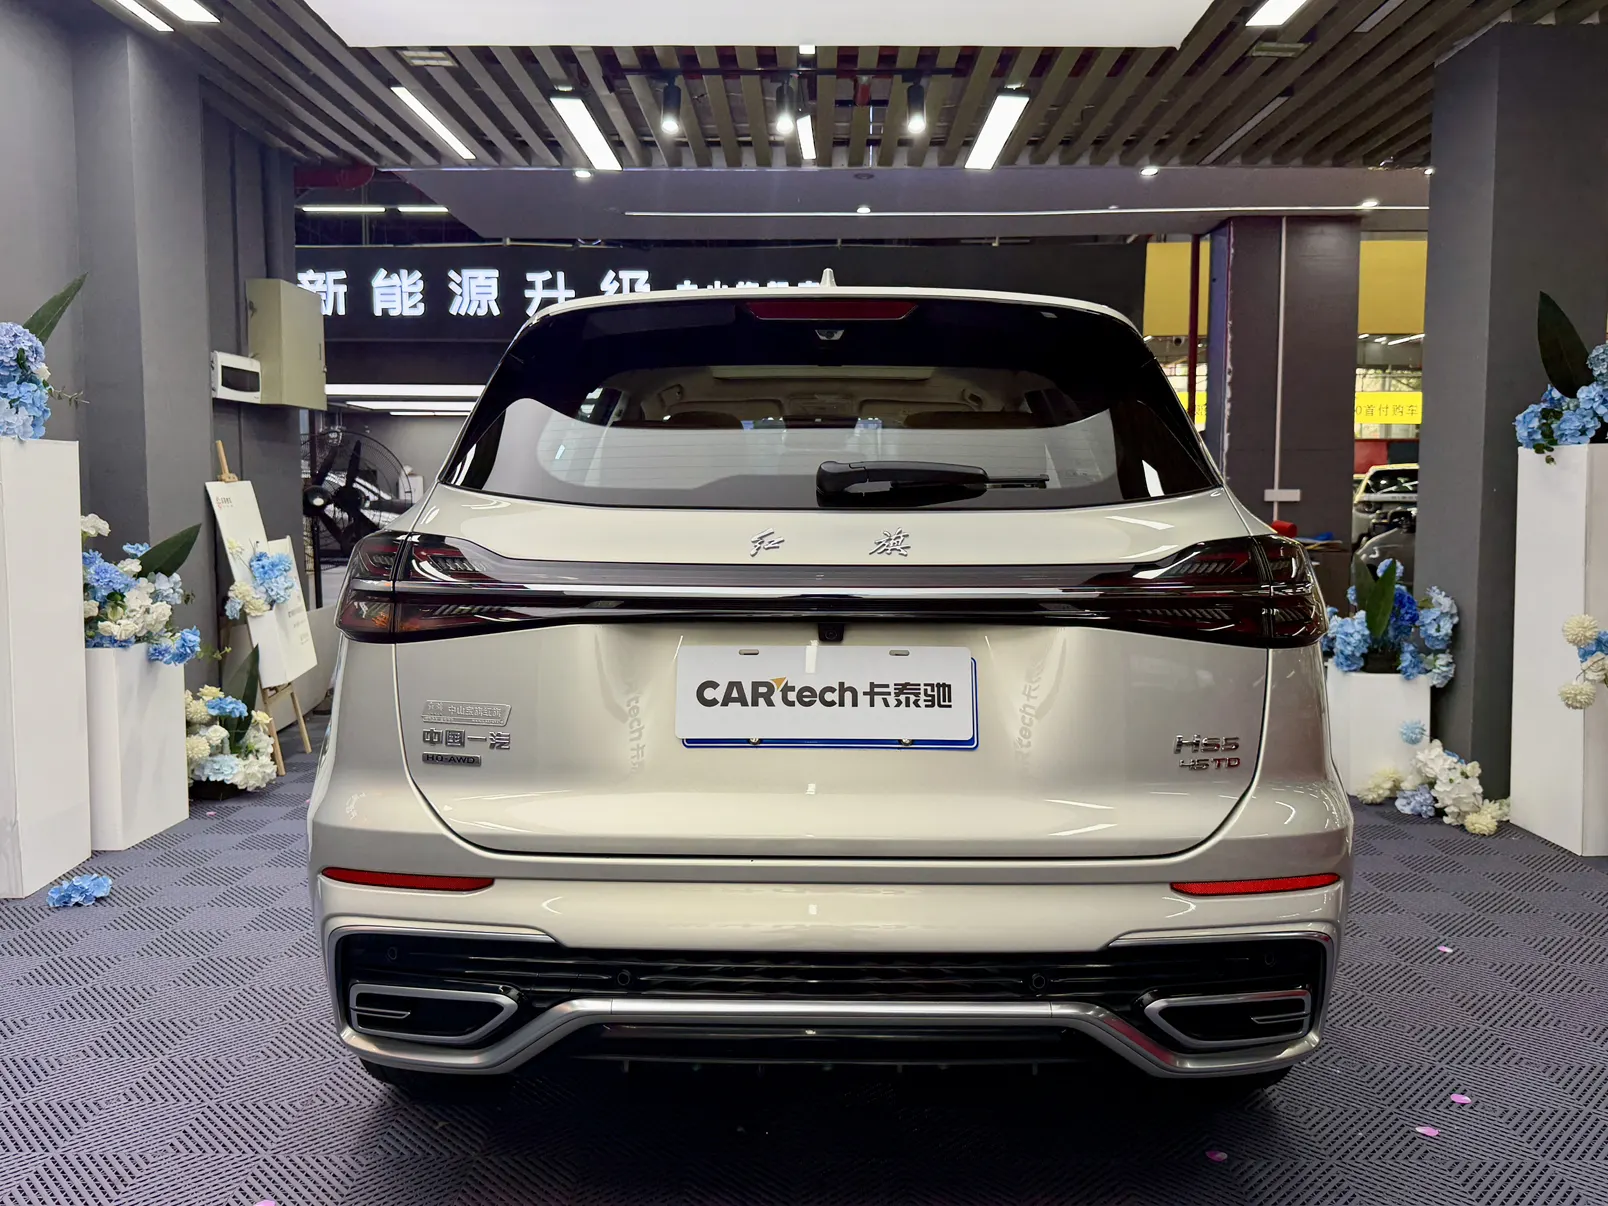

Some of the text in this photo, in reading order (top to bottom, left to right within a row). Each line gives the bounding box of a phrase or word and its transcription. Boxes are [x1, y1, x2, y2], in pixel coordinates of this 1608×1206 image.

[750, 527, 911, 557] 红旗
[862, 682, 952, 709] 卡泰驰
[422, 727, 511, 750] 中国一汽
[1174, 734, 1239, 754] HS5
[426, 753, 476, 765] HQ-AWD
[1179, 757, 1240, 771] 45TD
